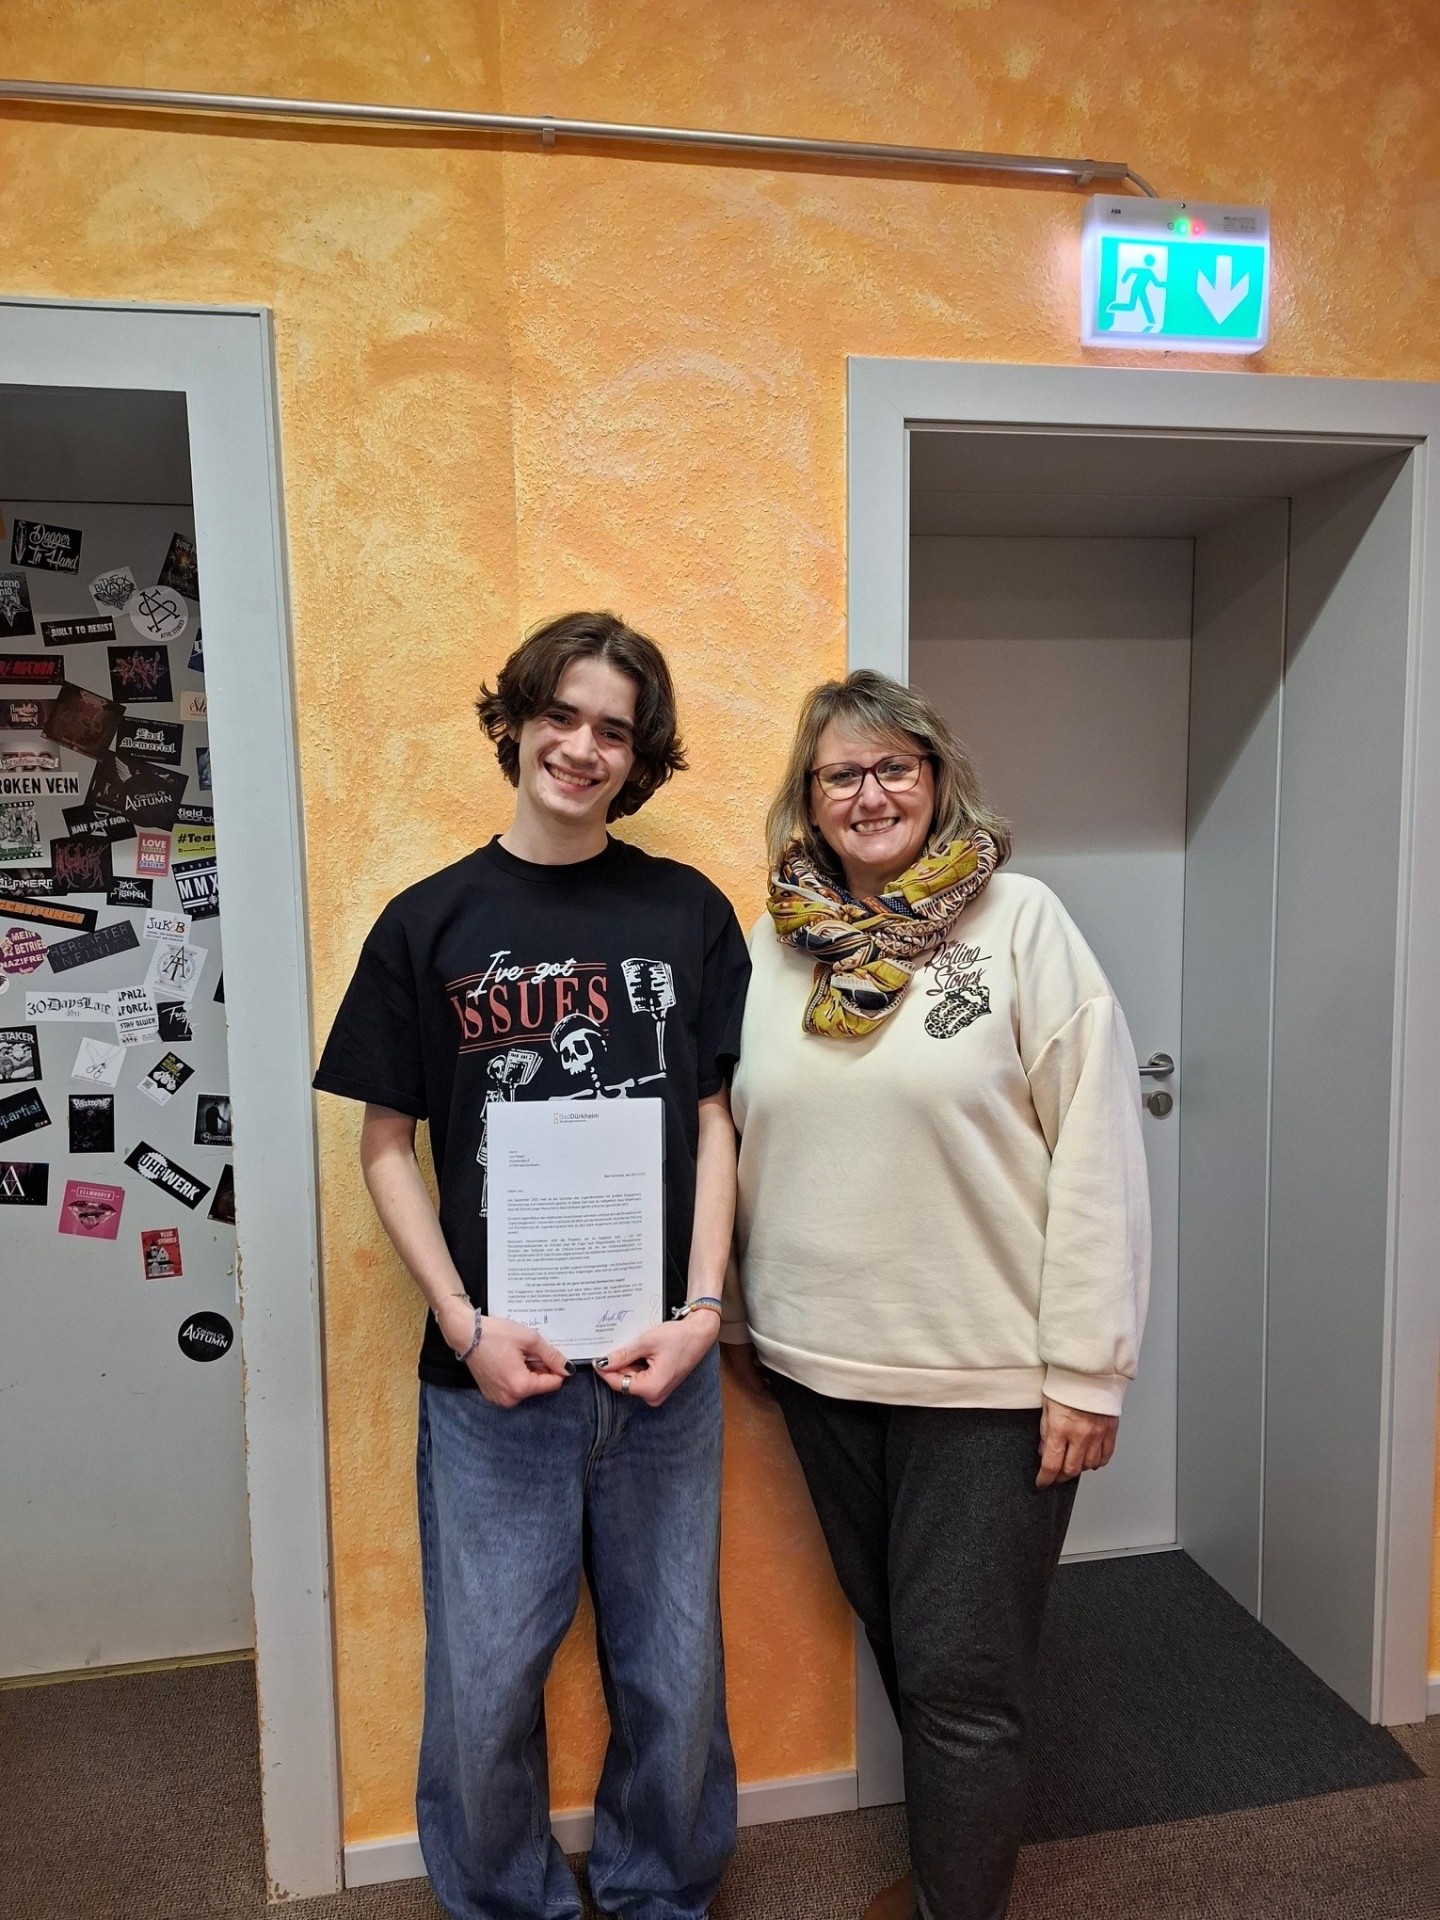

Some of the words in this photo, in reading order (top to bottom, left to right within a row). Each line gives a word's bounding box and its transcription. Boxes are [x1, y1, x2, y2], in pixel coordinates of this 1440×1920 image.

[29, 524, 71, 549] Dagger
[28, 545, 48, 564] In
[45, 550, 79, 570] Hand
[51, 626, 73, 637] BUILT
[75, 624, 86, 635] TO
[87, 622, 113, 634] RESIST
[119, 737, 176, 753] Memorial
[0, 777, 41, 794] OKEN
[46, 777, 79, 794] VEIN
[71, 823, 88, 835] HALF
[90, 819, 108, 832] PAST
[109, 815, 131, 827] EIGH
[142, 838, 167, 848] LOVE
[141, 853, 166, 863] HATE
[185, 904, 219, 915] CLOT
[10, 931, 36, 942] MEIN
[51, 924, 129, 957] HEREAFTER
[55, 937, 131, 967] INFINITY
[924, 941, 992, 973] Rolling
[467, 950, 524, 998] I've
[530, 957, 577, 984] got
[926, 964, 987, 996] Stones
[0, 1031, 35, 1044] ETAKER
[0, 1100, 41, 1129] partial
[140, 1153, 201, 1201] UHRWERK
[182, 1323, 228, 1349] AUTUMN
